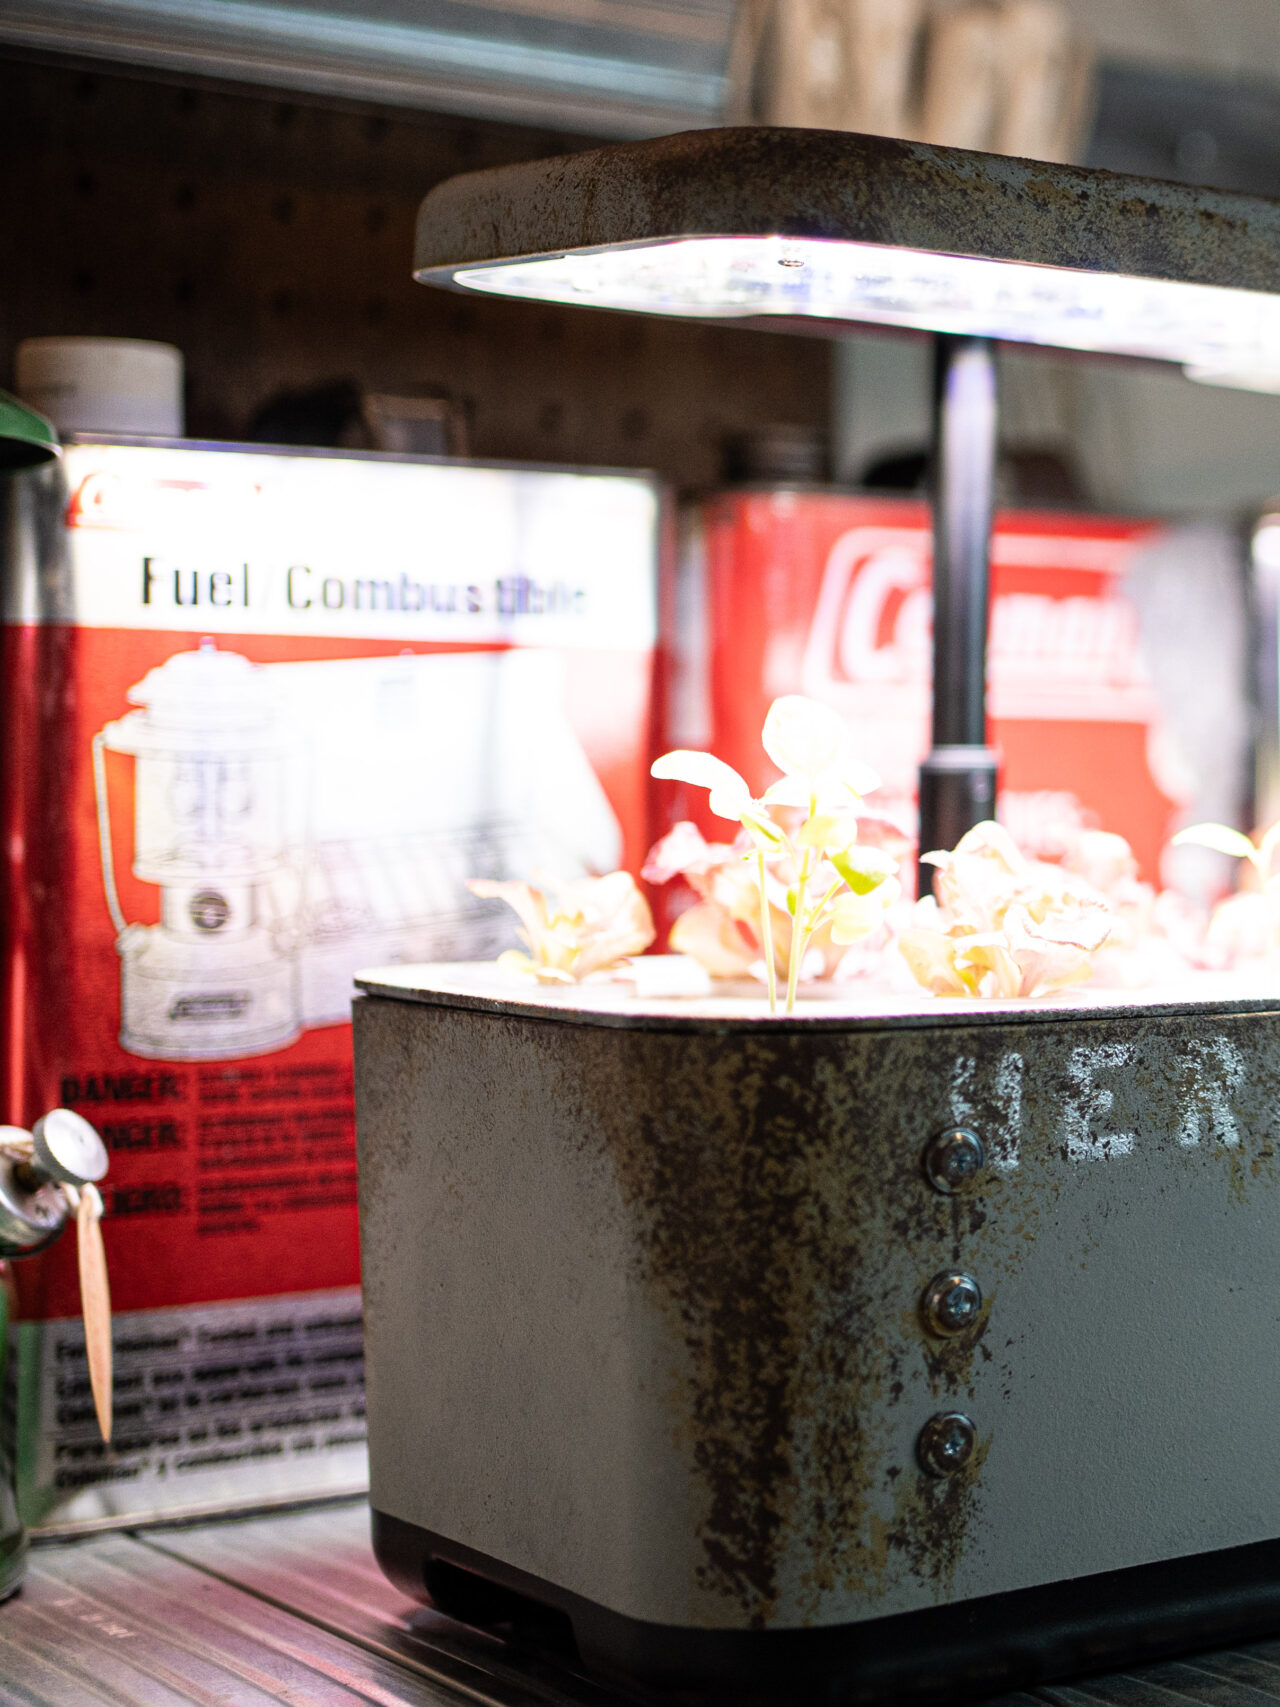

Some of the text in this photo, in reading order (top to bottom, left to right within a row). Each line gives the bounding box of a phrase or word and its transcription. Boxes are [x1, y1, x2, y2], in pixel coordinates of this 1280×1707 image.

[141, 555, 588, 616] Fuel Combus
[60, 1070, 179, 1106] DANR
